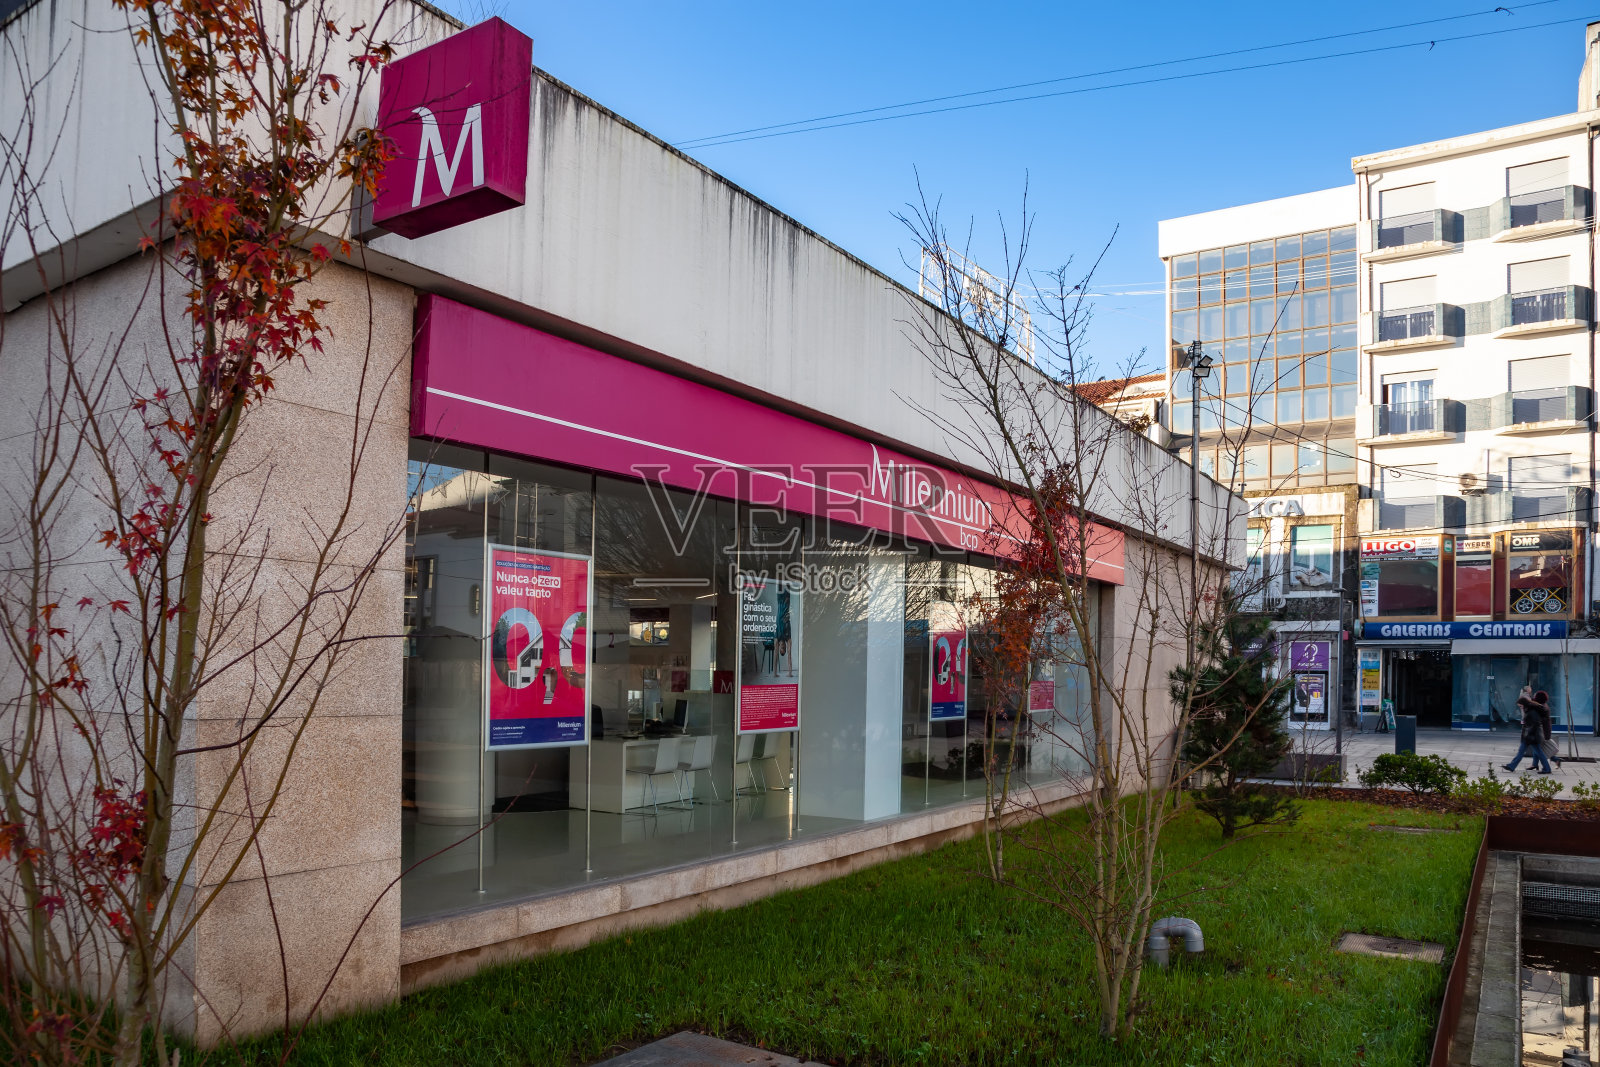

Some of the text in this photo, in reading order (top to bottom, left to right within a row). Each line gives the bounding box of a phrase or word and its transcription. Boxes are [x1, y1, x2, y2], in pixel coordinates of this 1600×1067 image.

[411, 102, 485, 208] M
[871, 443, 992, 528] Millennium
[960, 526, 979, 552] bcp
[1465, 541, 1491, 549] WEBER
[1512, 537, 1540, 547] OMP
[1362, 540, 1415, 553] LUGO
[496, 570, 529, 584] Nunca
[539, 577, 560, 587] zero
[496, 585, 552, 599] valeu tanto
[743, 602, 772, 613] ginástica
[743, 614, 758, 622] com
[765, 615, 776, 623] seu
[743, 623, 777, 633] ordenado?
[1381, 623, 1551, 637] GALERIAS CENTRAIS
[557, 721, 582, 729] Millennium
